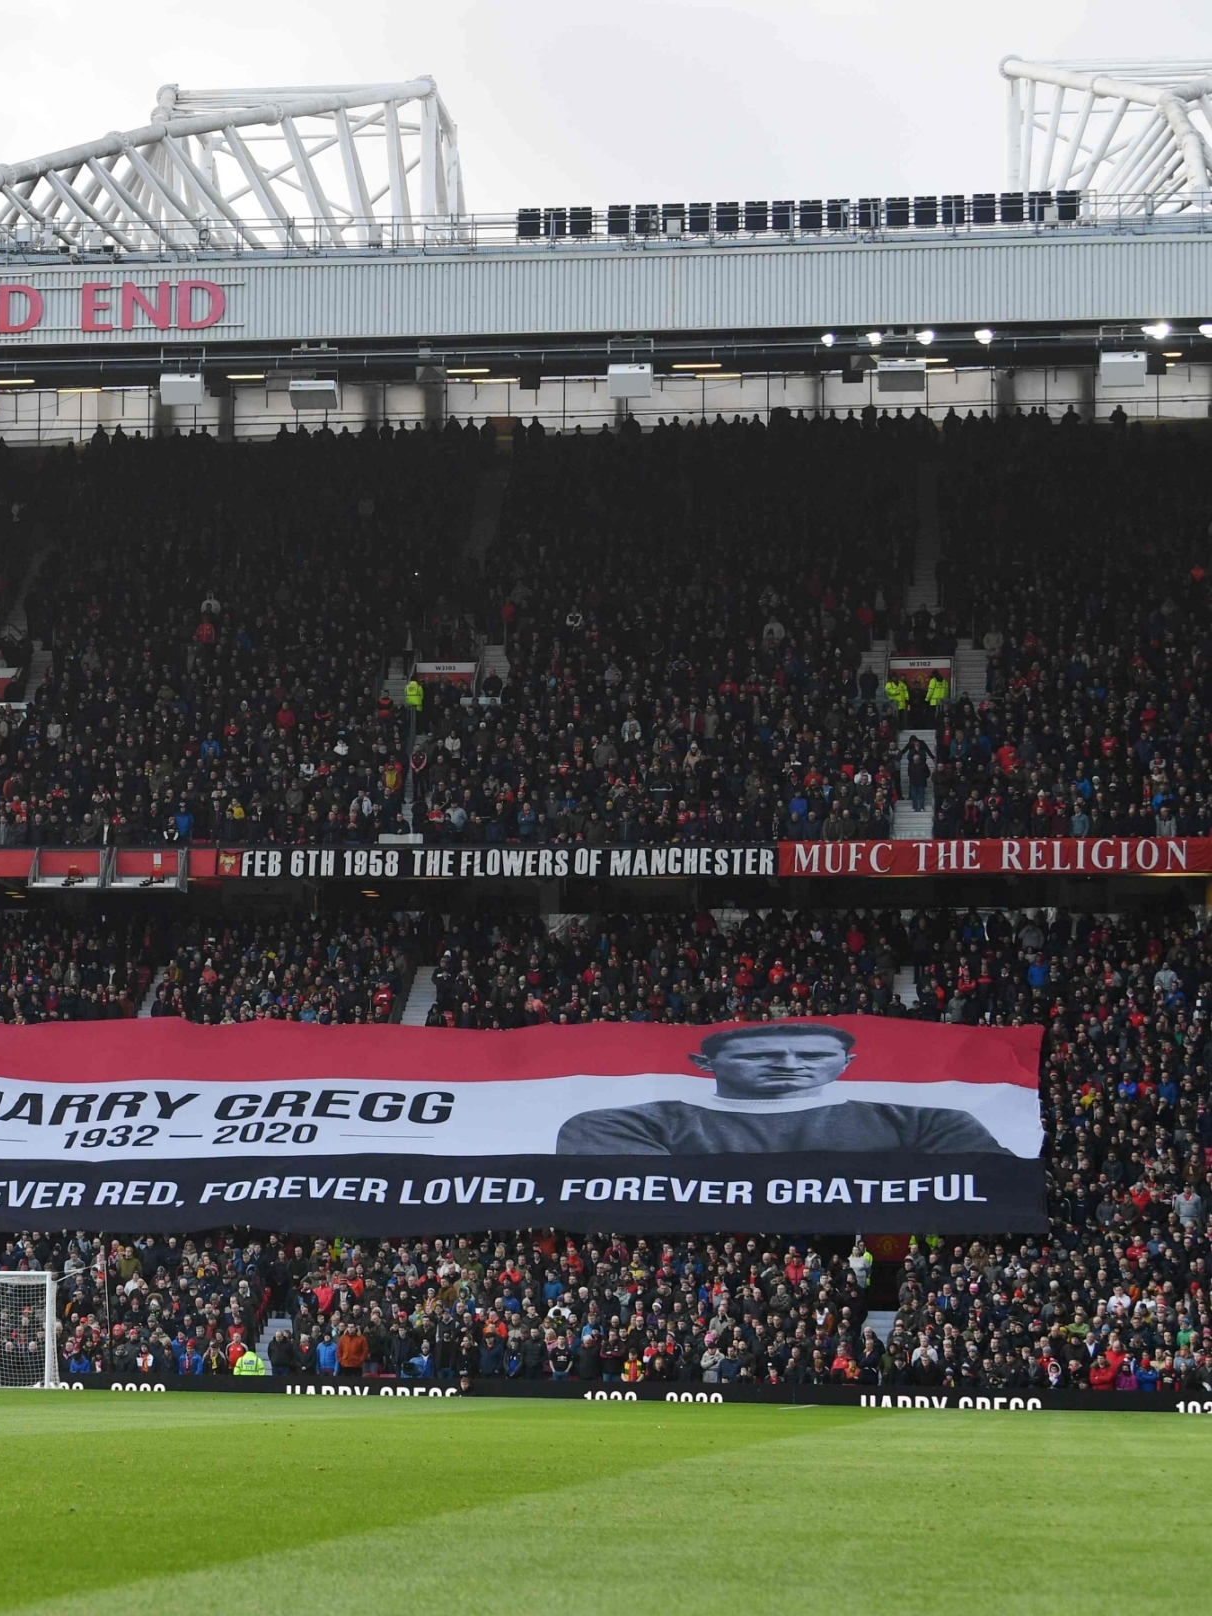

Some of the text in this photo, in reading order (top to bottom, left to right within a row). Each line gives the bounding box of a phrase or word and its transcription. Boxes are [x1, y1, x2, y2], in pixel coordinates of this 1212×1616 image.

[81, 280, 226, 332] END
[242, 848, 773, 876] FEB 6TH 1958 THE FLOWERS OF MANCHESTER
[795, 839, 1188, 873] MUFC THE RELIGION
[215, 1091, 454, 1124] GREGG
[63, 1125, 156, 1149] 1932
[212, 1122, 317, 1144] 2020
[94, 1181, 184, 1207] RED,
[200, 1177, 388, 1203] FOREVER
[400, 1177, 544, 1204] LOVED,
[560, 1176, 752, 1203] FOREVER
[767, 1175, 986, 1203] GRATEFUL
